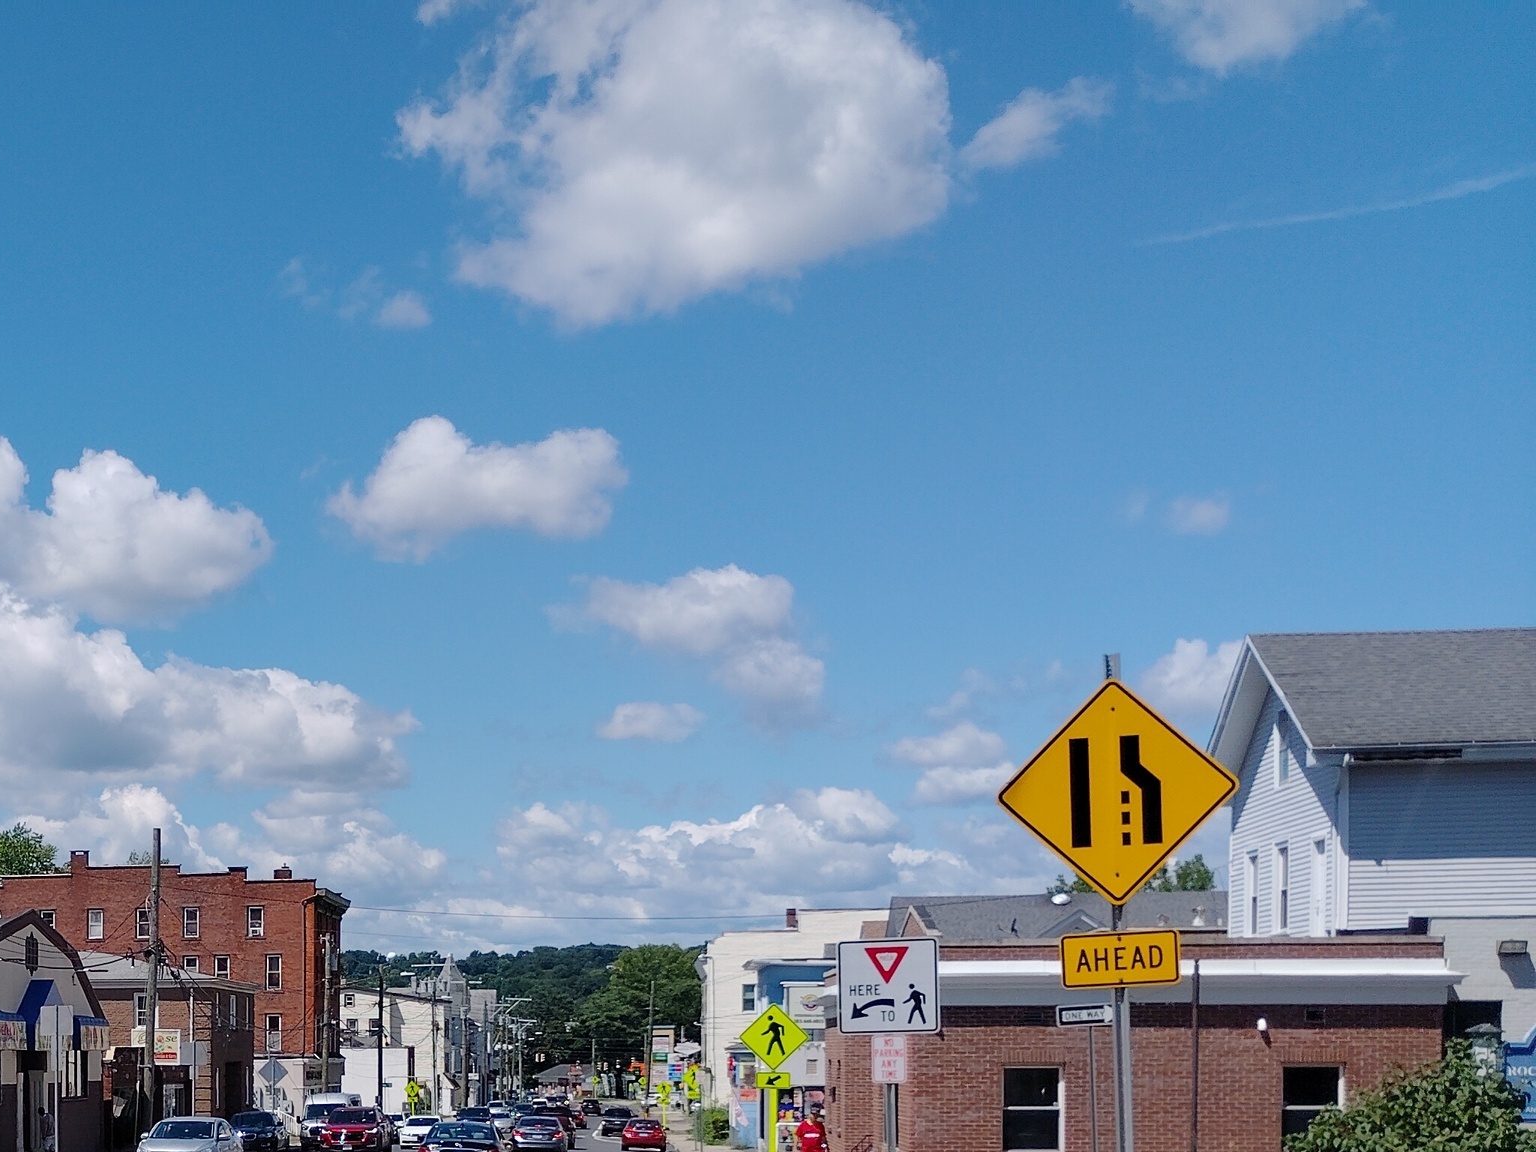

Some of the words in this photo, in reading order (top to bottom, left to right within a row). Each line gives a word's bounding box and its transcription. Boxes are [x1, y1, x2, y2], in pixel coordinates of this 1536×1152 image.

[1076, 945, 1163, 973] AHEAD
[849, 984, 881, 996] HERE
[880, 1010, 896, 1022] TO
[1065, 1011, 1084, 1021] ONE
[1087, 1010, 1105, 1019] WAY
[884, 1038, 894, 1047] NO
[874, 1049, 904, 1057] PARKING
[881, 1059, 897, 1068] ANY
[881, 1070, 897, 1079] TIME
